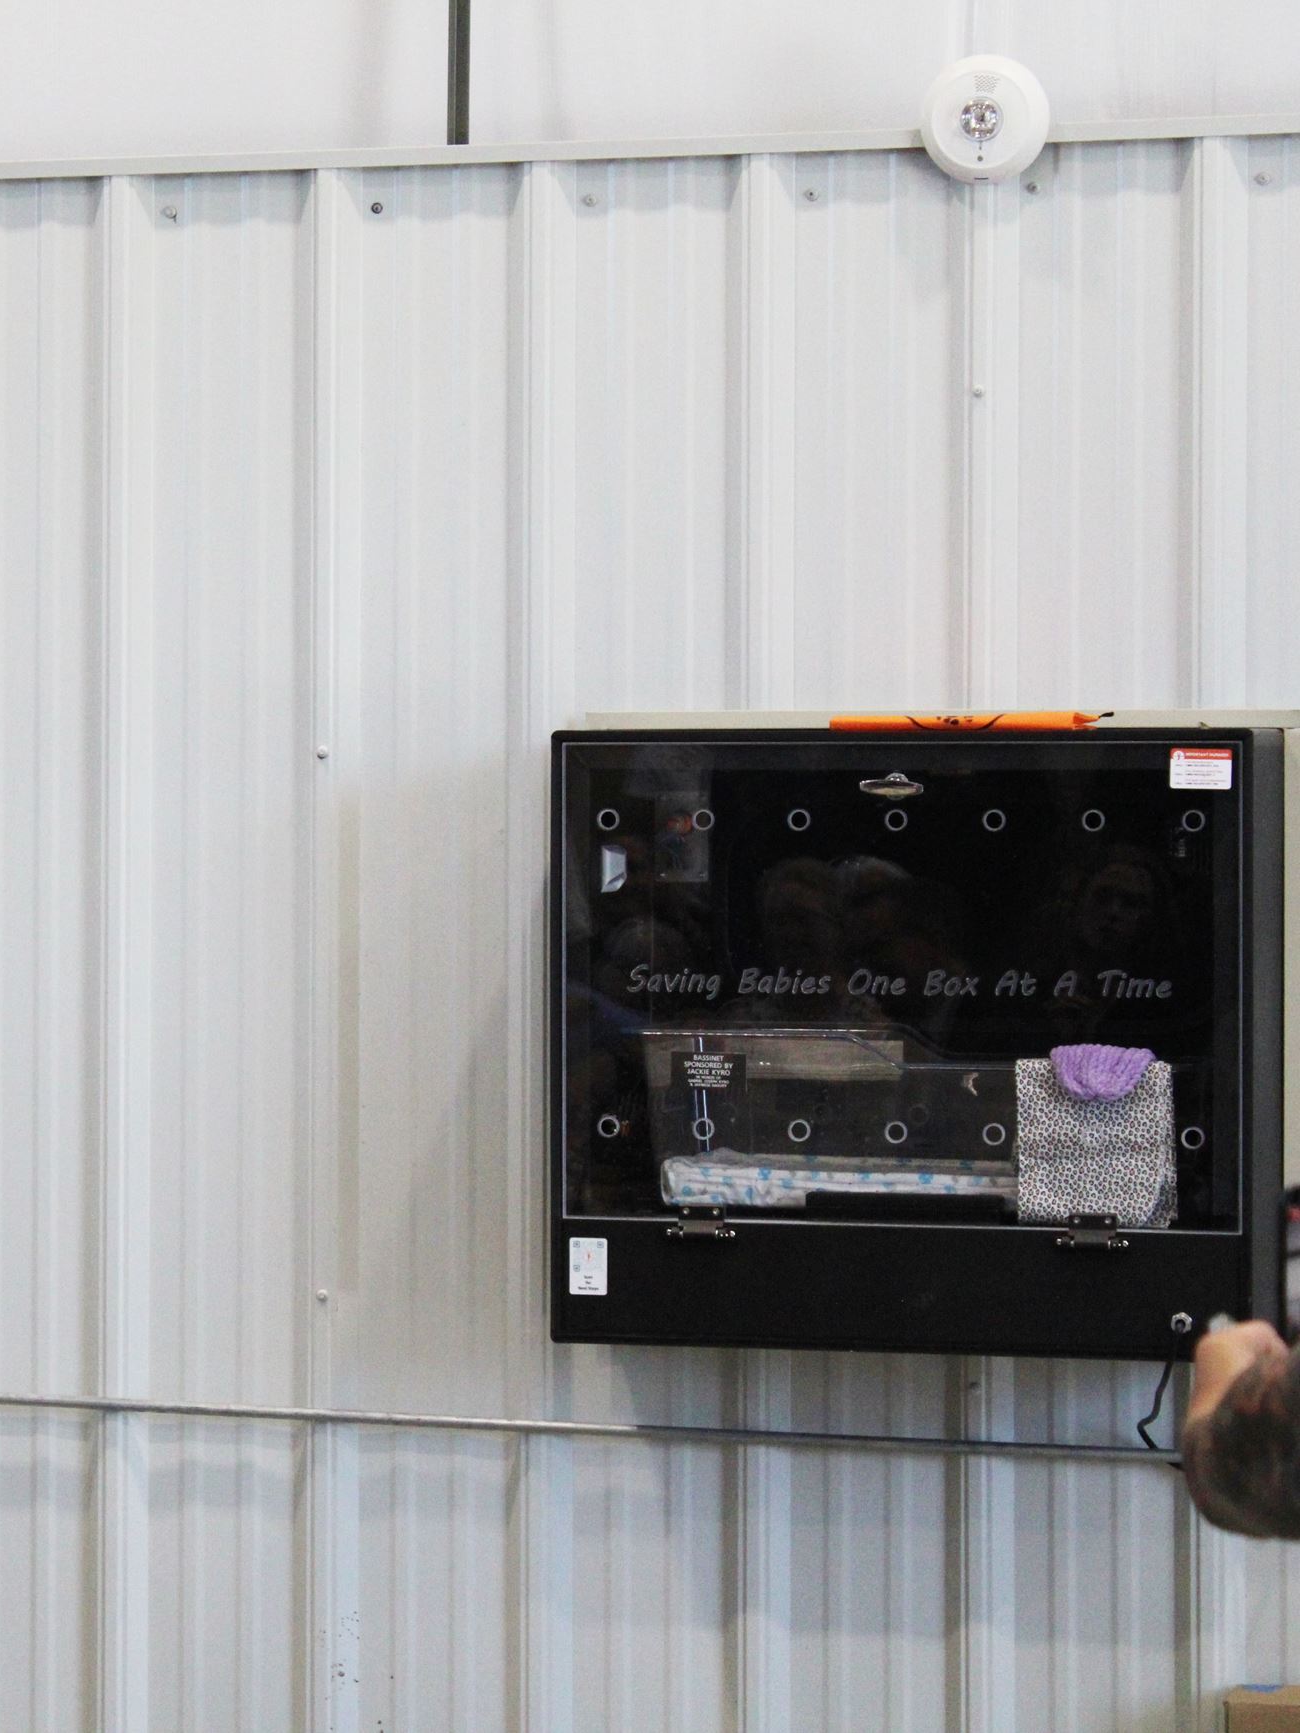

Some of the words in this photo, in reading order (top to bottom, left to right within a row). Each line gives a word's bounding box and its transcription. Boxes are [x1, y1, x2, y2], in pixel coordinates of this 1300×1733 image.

[627, 963, 721, 1000] Saving
[737, 966, 832, 995] Babies
[847, 968, 907, 996] One
[923, 969, 980, 997] Box
[995, 969, 1037, 997] At
[1053, 970, 1078, 998] A
[1097, 969, 1173, 999] Time
[693, 1054, 724, 1062] BASSINET
[684, 1061, 723, 1069] SPONSORED
